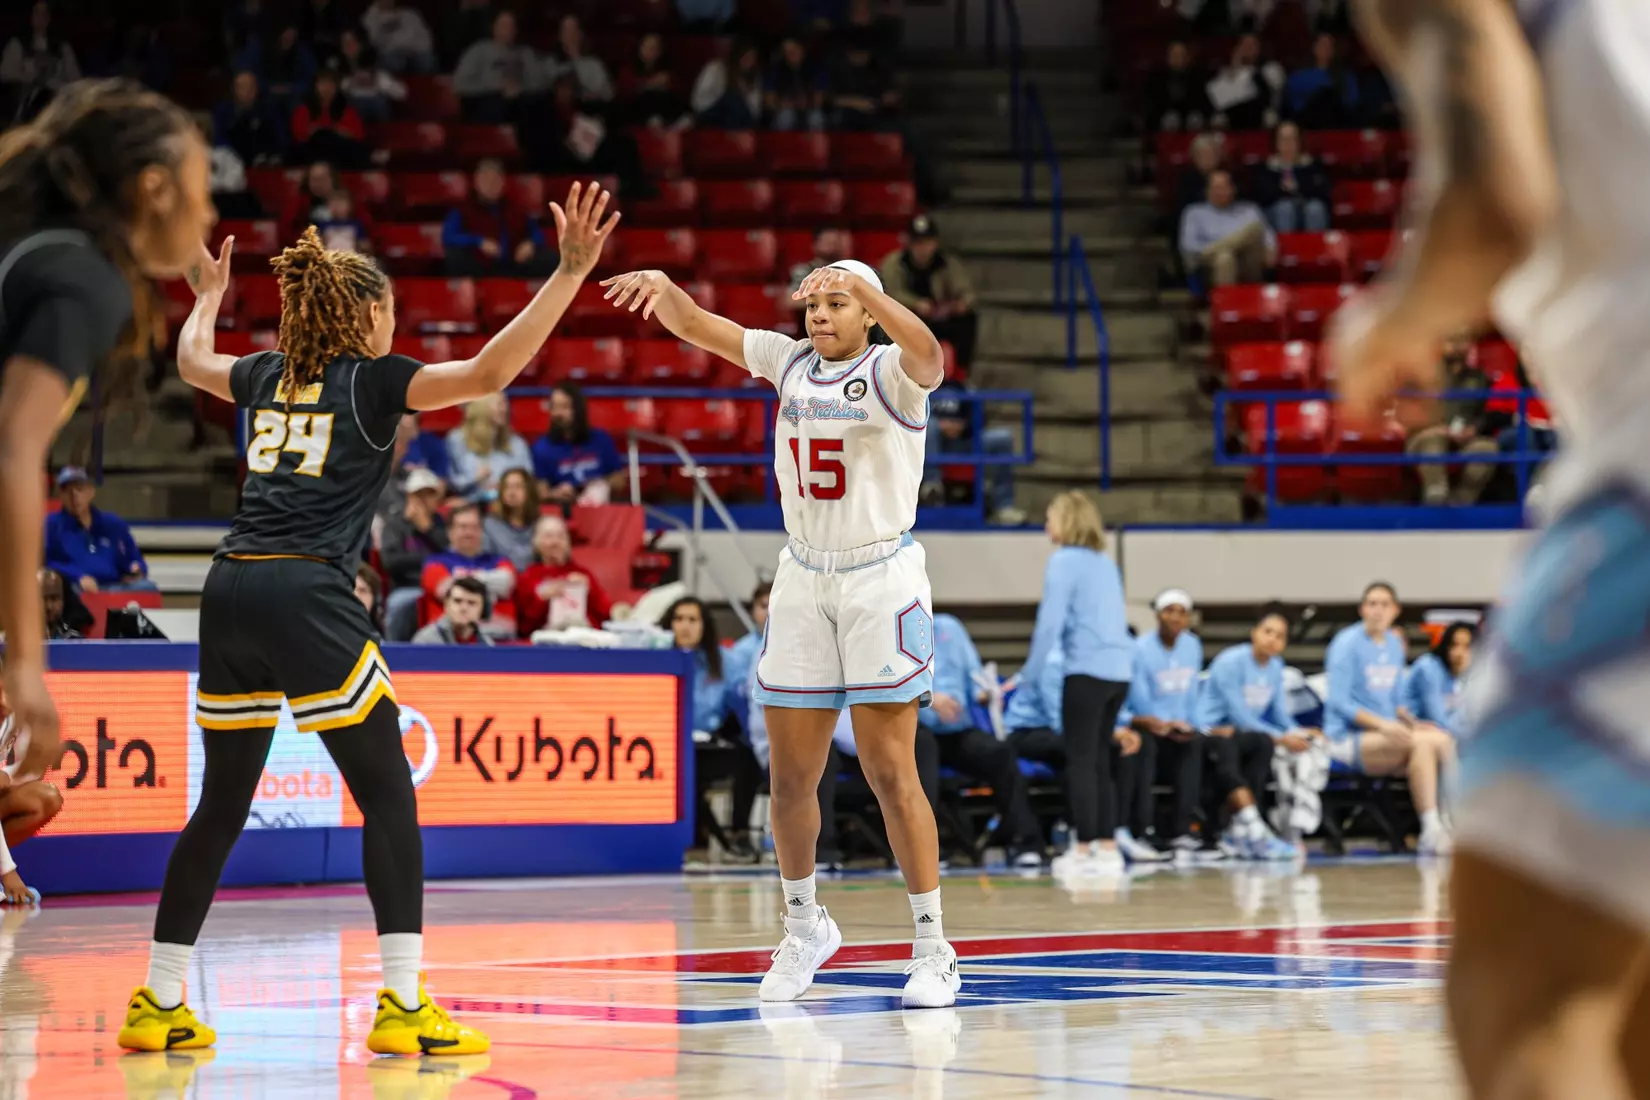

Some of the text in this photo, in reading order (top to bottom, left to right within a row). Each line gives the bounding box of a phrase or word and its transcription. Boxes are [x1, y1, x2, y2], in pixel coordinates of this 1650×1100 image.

[247, 409, 335, 477] 24
[53, 717, 156, 788] ota
[252, 766, 333, 799] bota
[454, 717, 656, 782] Kubota
